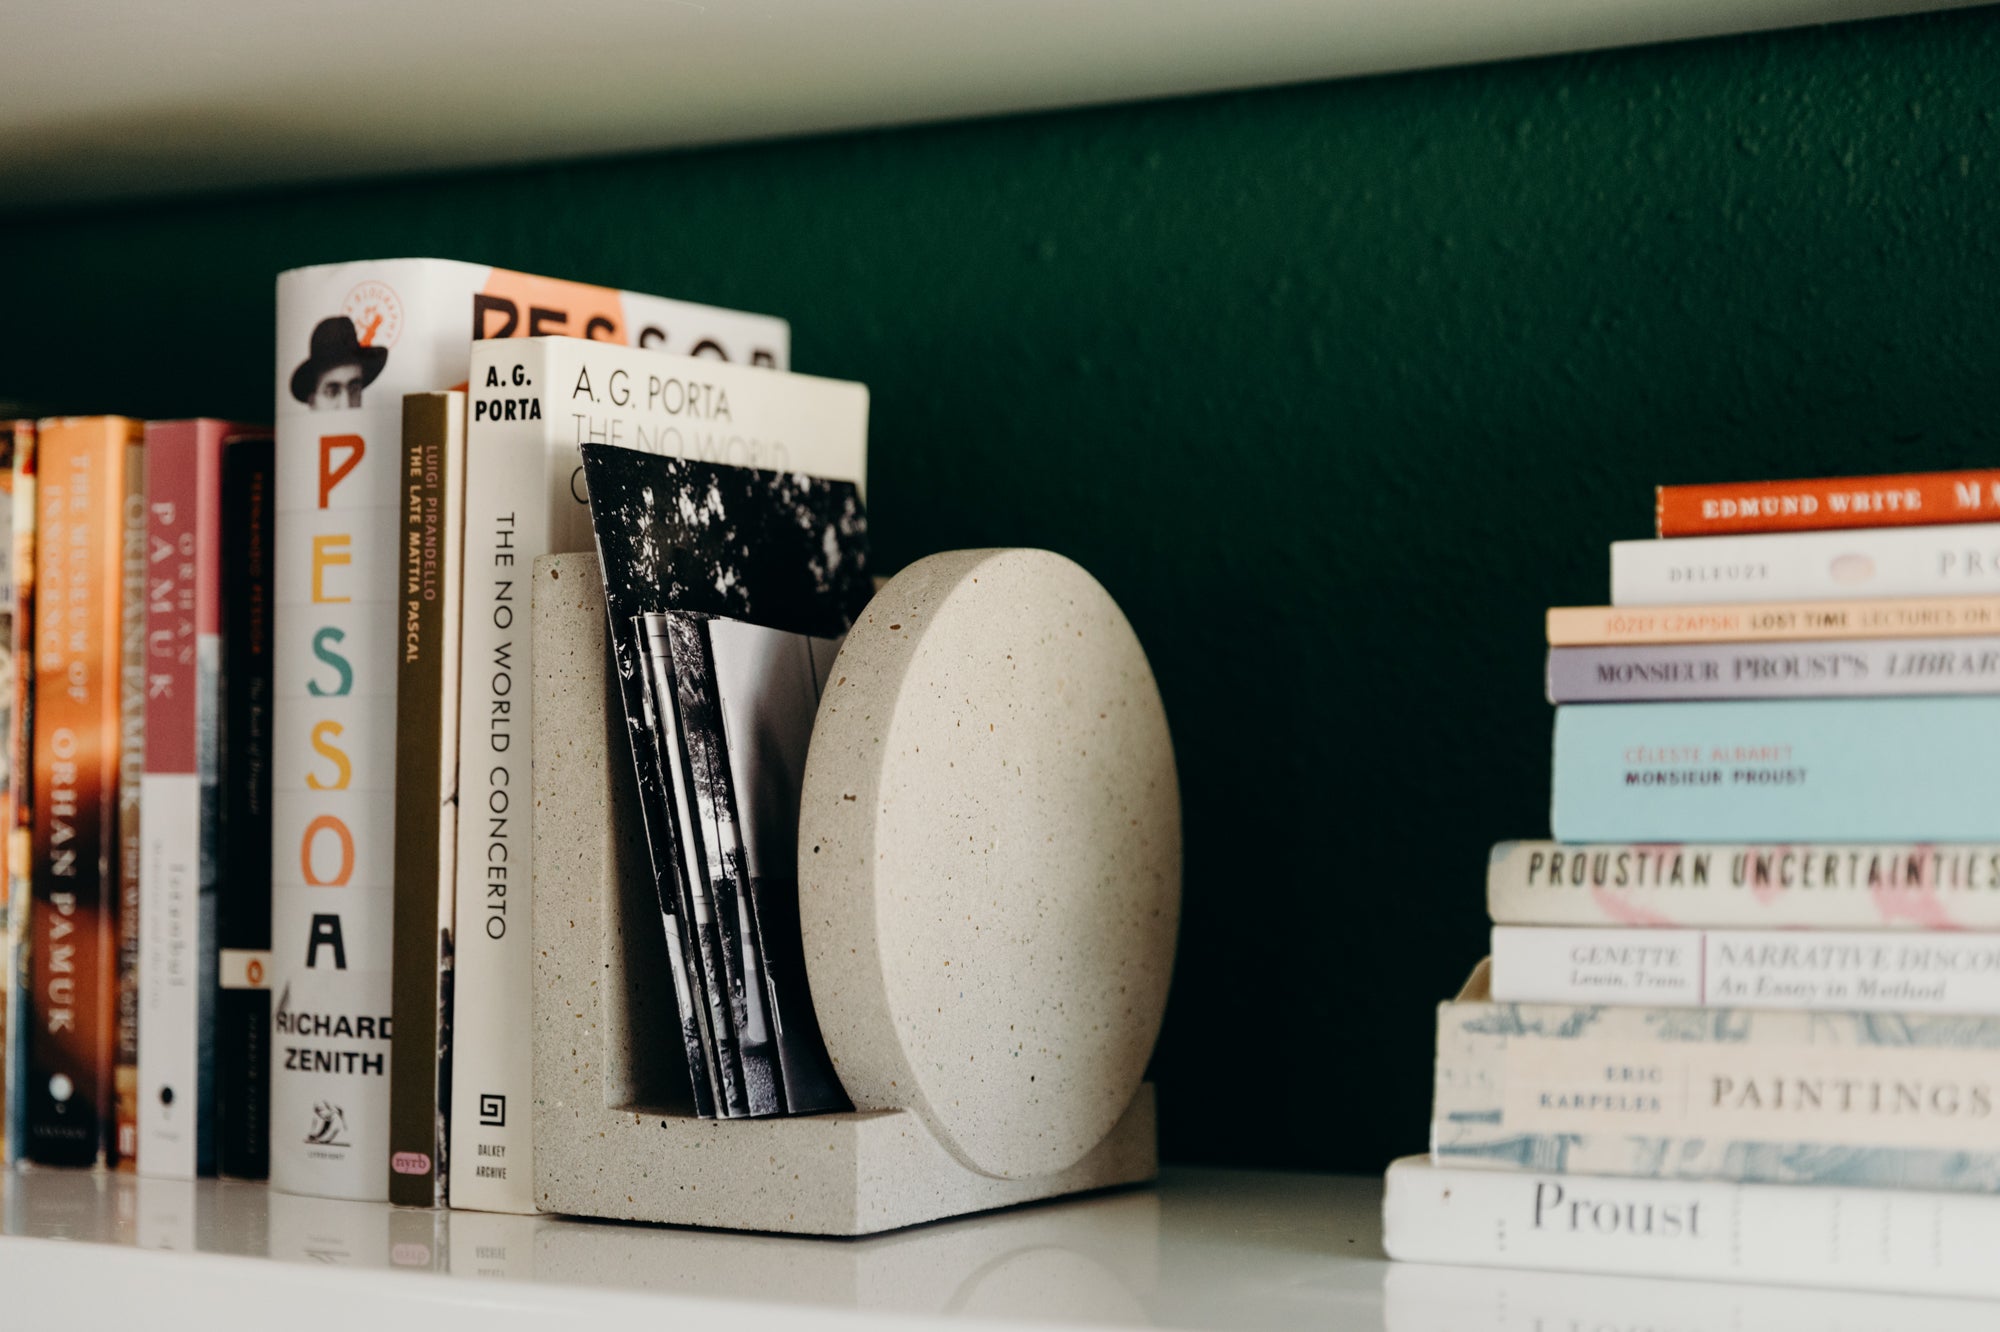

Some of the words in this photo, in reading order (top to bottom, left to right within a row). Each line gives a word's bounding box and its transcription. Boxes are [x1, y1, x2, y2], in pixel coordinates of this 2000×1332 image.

[475, 398, 542, 422] PORTA
[649, 375, 732, 423] PORTA
[409, 445, 423, 477] THE
[425, 445, 438, 489] LUIGI
[408, 486, 421, 524] LATE
[1703, 494, 1819, 520] EDMUND
[1829, 489, 1922, 514] WHITE
[423, 498, 437, 601] PIRANDELLO
[496, 512, 515, 566] THE
[407, 531, 421, 594] MATTIA
[1670, 563, 1770, 583] DELEUZE
[149, 501, 176, 700] PAMUK
[176, 532, 195, 665] ORHAN
[494, 581, 513, 629] NO
[405, 600, 420, 663] PASCAL
[1749, 613, 1798, 630] LOST
[1804, 611, 1848, 629] TIME
[1596, 659, 1719, 685] MONSIEUR
[300, 434, 366, 970] PESSOA
[491, 641, 512, 752] WORLD
[1711, 745, 1795, 763] ALBARET
[1624, 770, 1723, 787] MONSIEUR
[1733, 768, 1808, 786] PROUST
[51, 727, 78, 877] ORHAN
[486, 767, 510, 940] CONCERTO
[1528, 852, 1711, 888] PROUSTIAN
[48, 893, 76, 1035] PAMUK
[1570, 945, 1682, 967] GENETTE
[1718, 943, 1890, 971] NARRATIVE
[1899, 946, 2000, 972] DISCO
[284, 1048, 384, 1076] ZENITH
[1606, 1066, 1663, 1082] ERIC
[1711, 1076, 1993, 1118] PAINTINGS
[395, 1156, 427, 1173] nyrb
[477, 1144, 506, 1158] DALKEY
[476, 1166, 507, 1180] ARCHIVE
[1532, 1181, 1703, 1238] Proust
